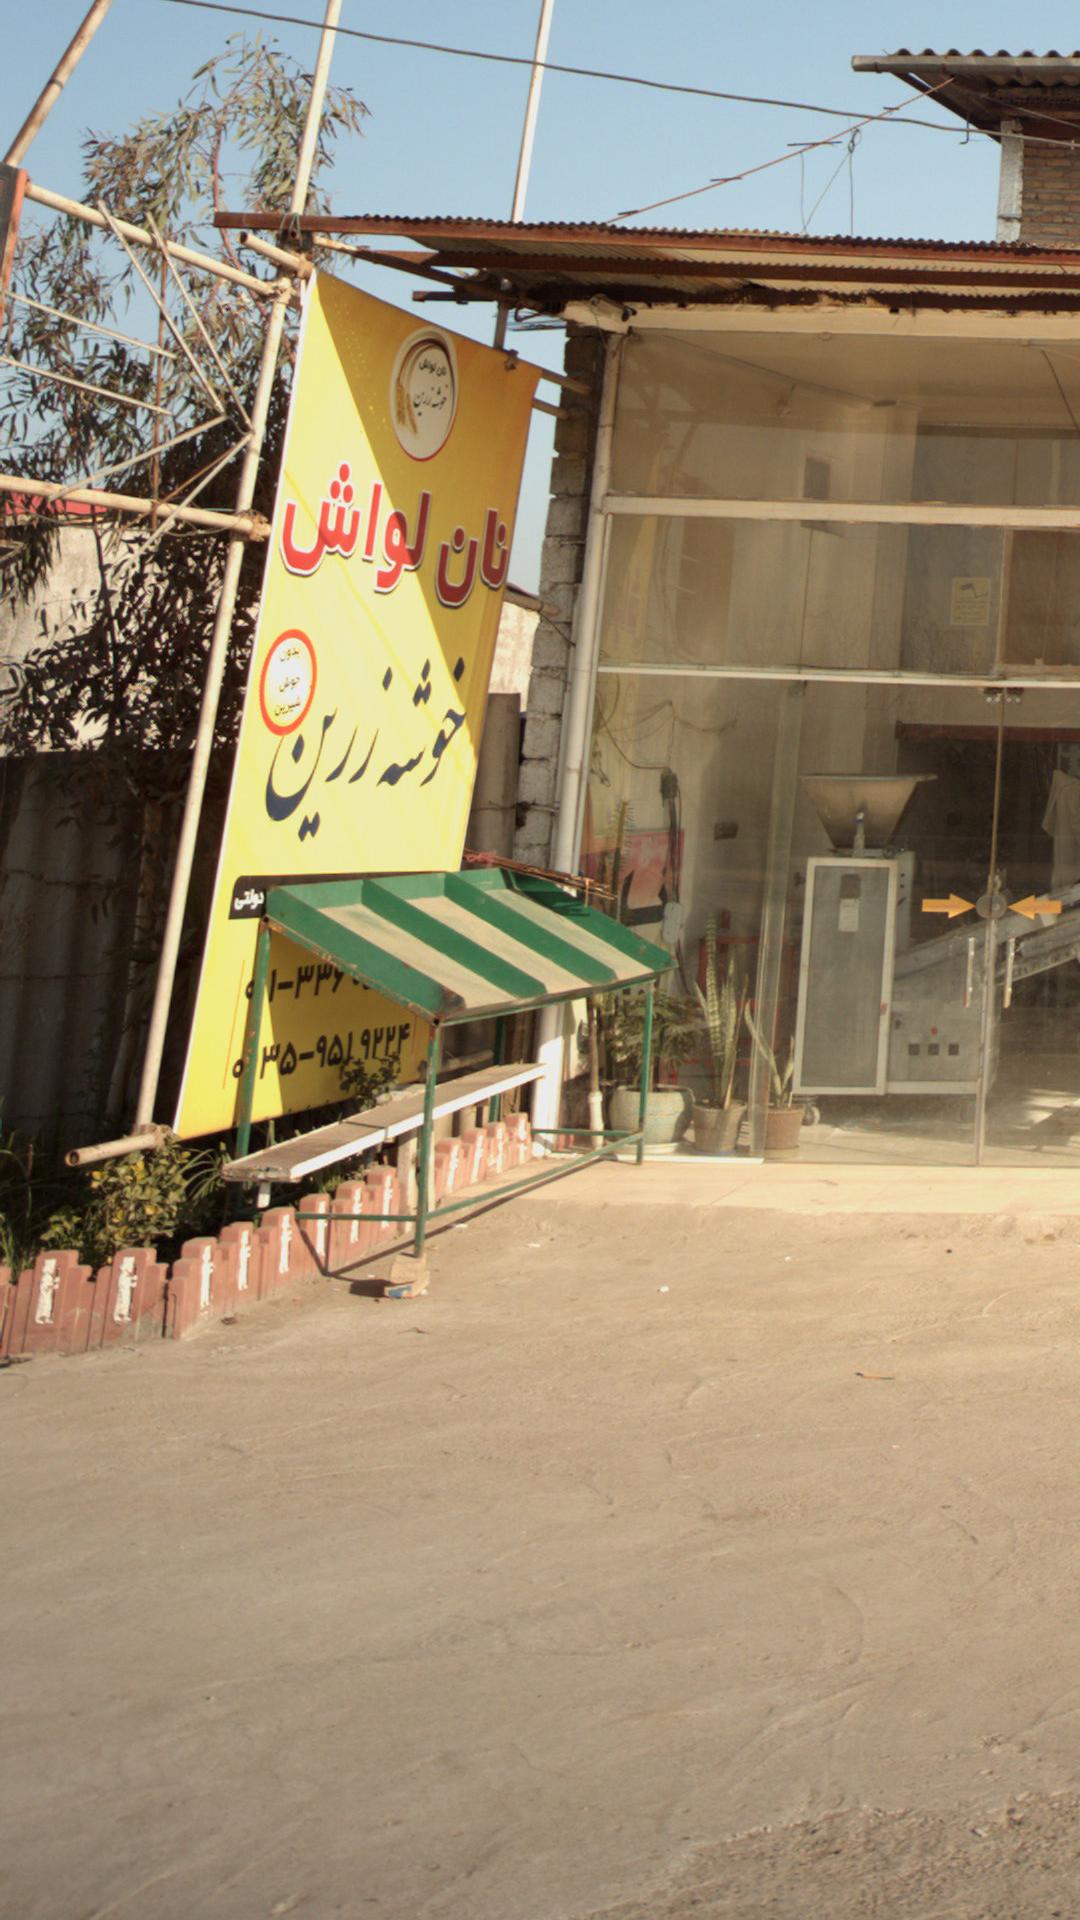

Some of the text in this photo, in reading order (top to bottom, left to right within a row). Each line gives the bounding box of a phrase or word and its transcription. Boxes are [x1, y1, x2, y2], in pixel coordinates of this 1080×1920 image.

[280, 462, 509, 607] نان لواش
[265, 656, 467, 842] خوشه زرین
